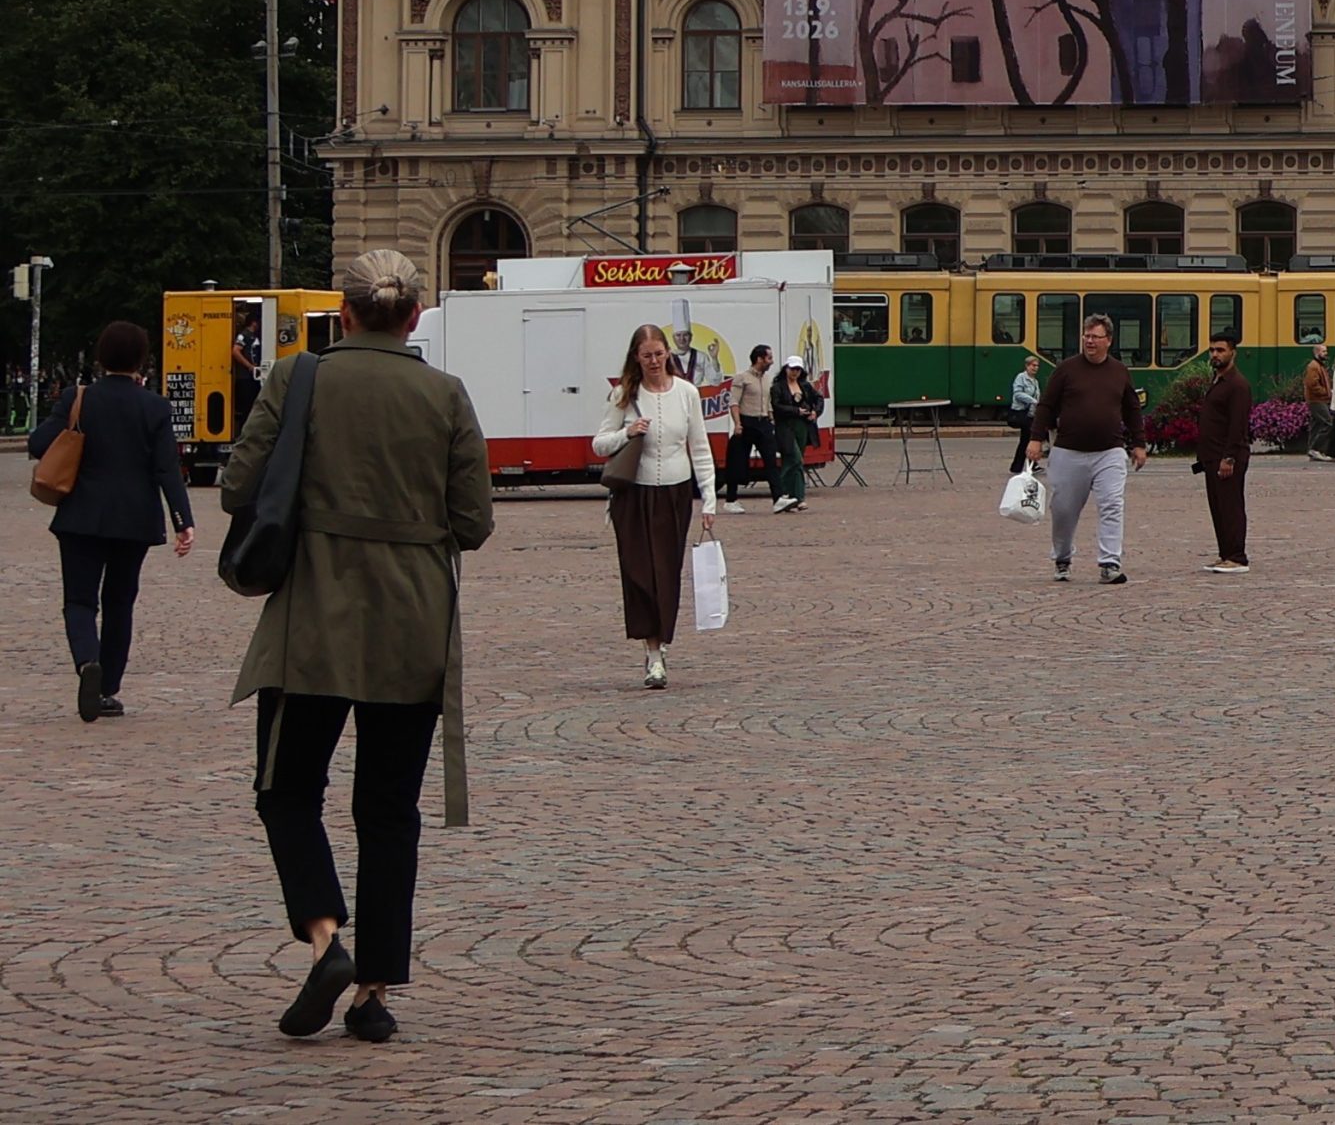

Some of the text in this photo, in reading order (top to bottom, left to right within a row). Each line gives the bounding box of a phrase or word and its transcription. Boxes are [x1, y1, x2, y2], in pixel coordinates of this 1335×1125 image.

[783, 20, 839, 39] 2026
[781, 79, 857, 88] KANSALLISGALLERIA
[594, 260, 664, 283] Seiska
